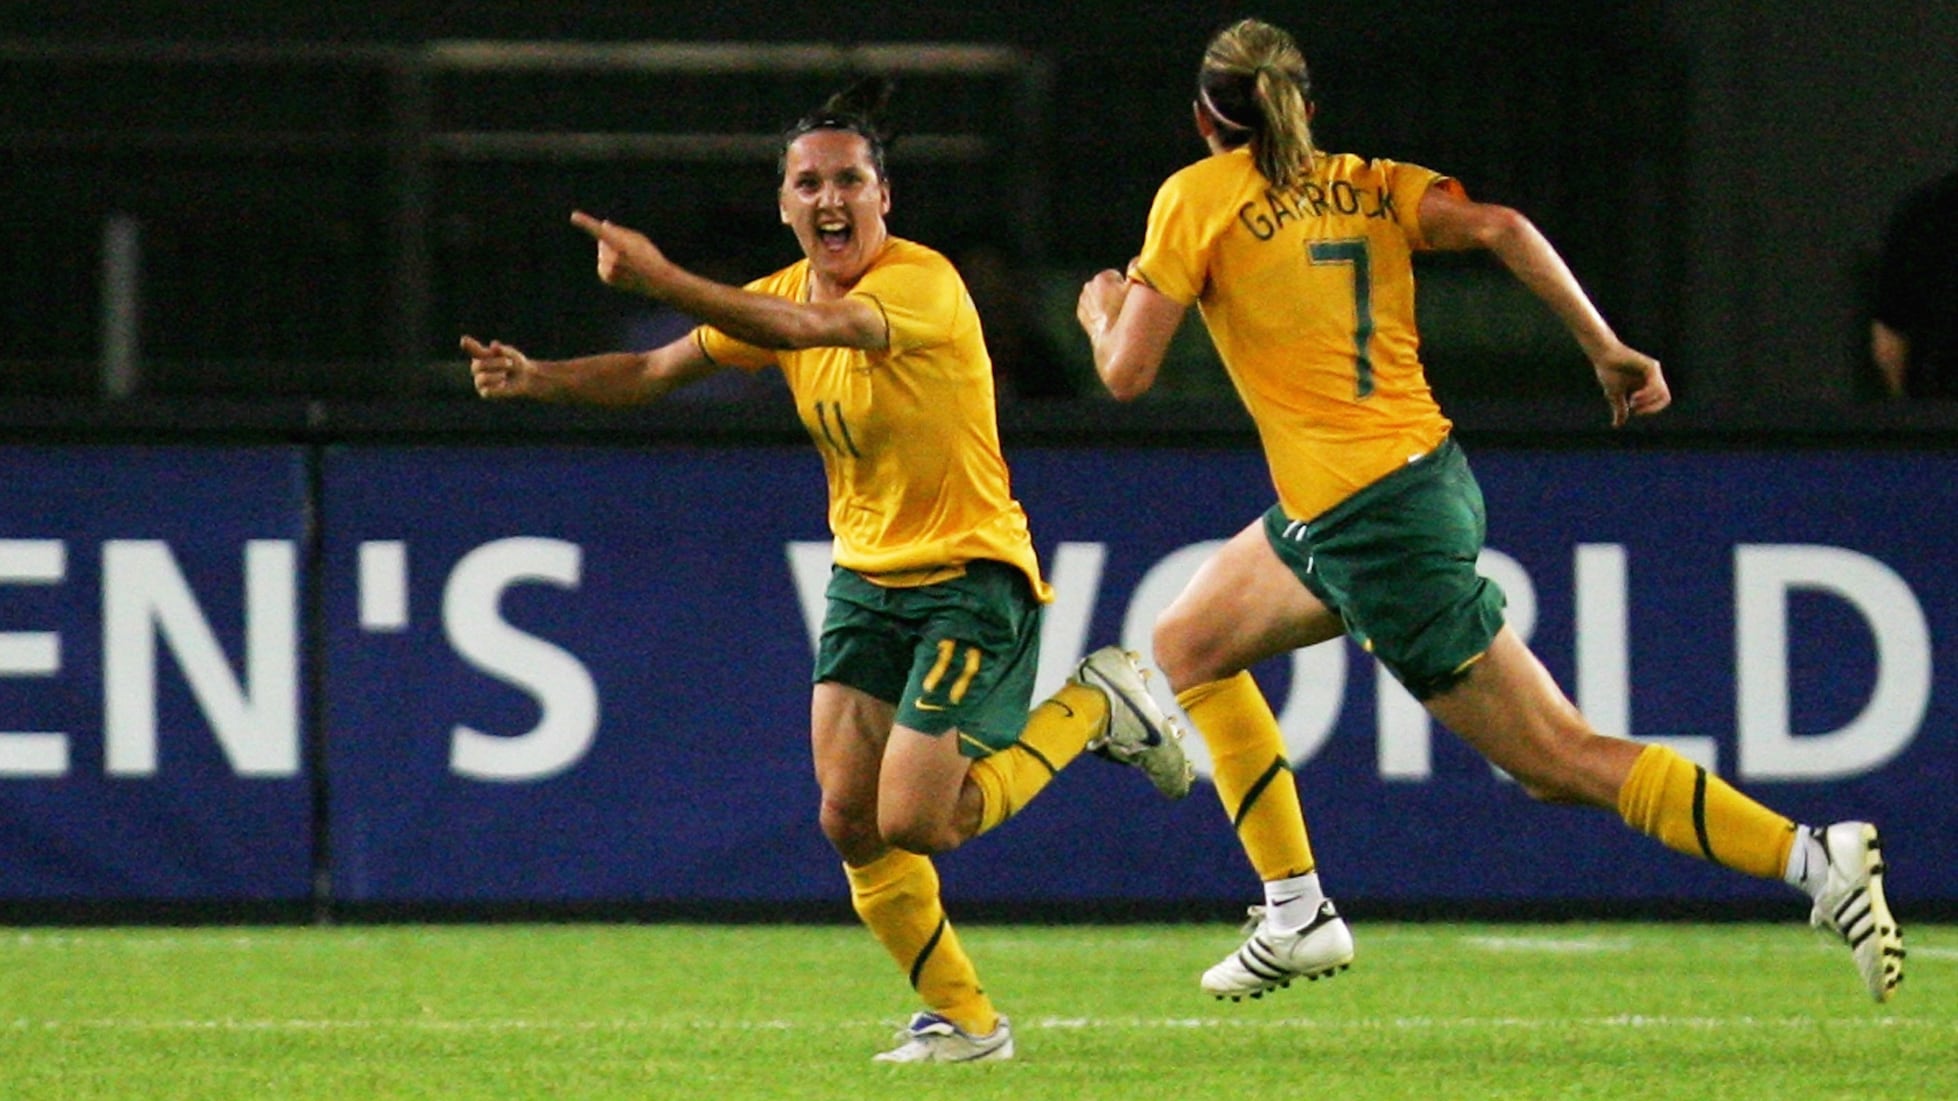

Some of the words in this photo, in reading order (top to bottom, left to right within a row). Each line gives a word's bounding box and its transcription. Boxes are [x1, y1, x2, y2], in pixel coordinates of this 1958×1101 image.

[1239, 180, 1399, 241] GARROCK
[1305, 236, 1374, 402] 7
[815, 401, 861, 459] 11
[922, 638, 982, 705] 11
